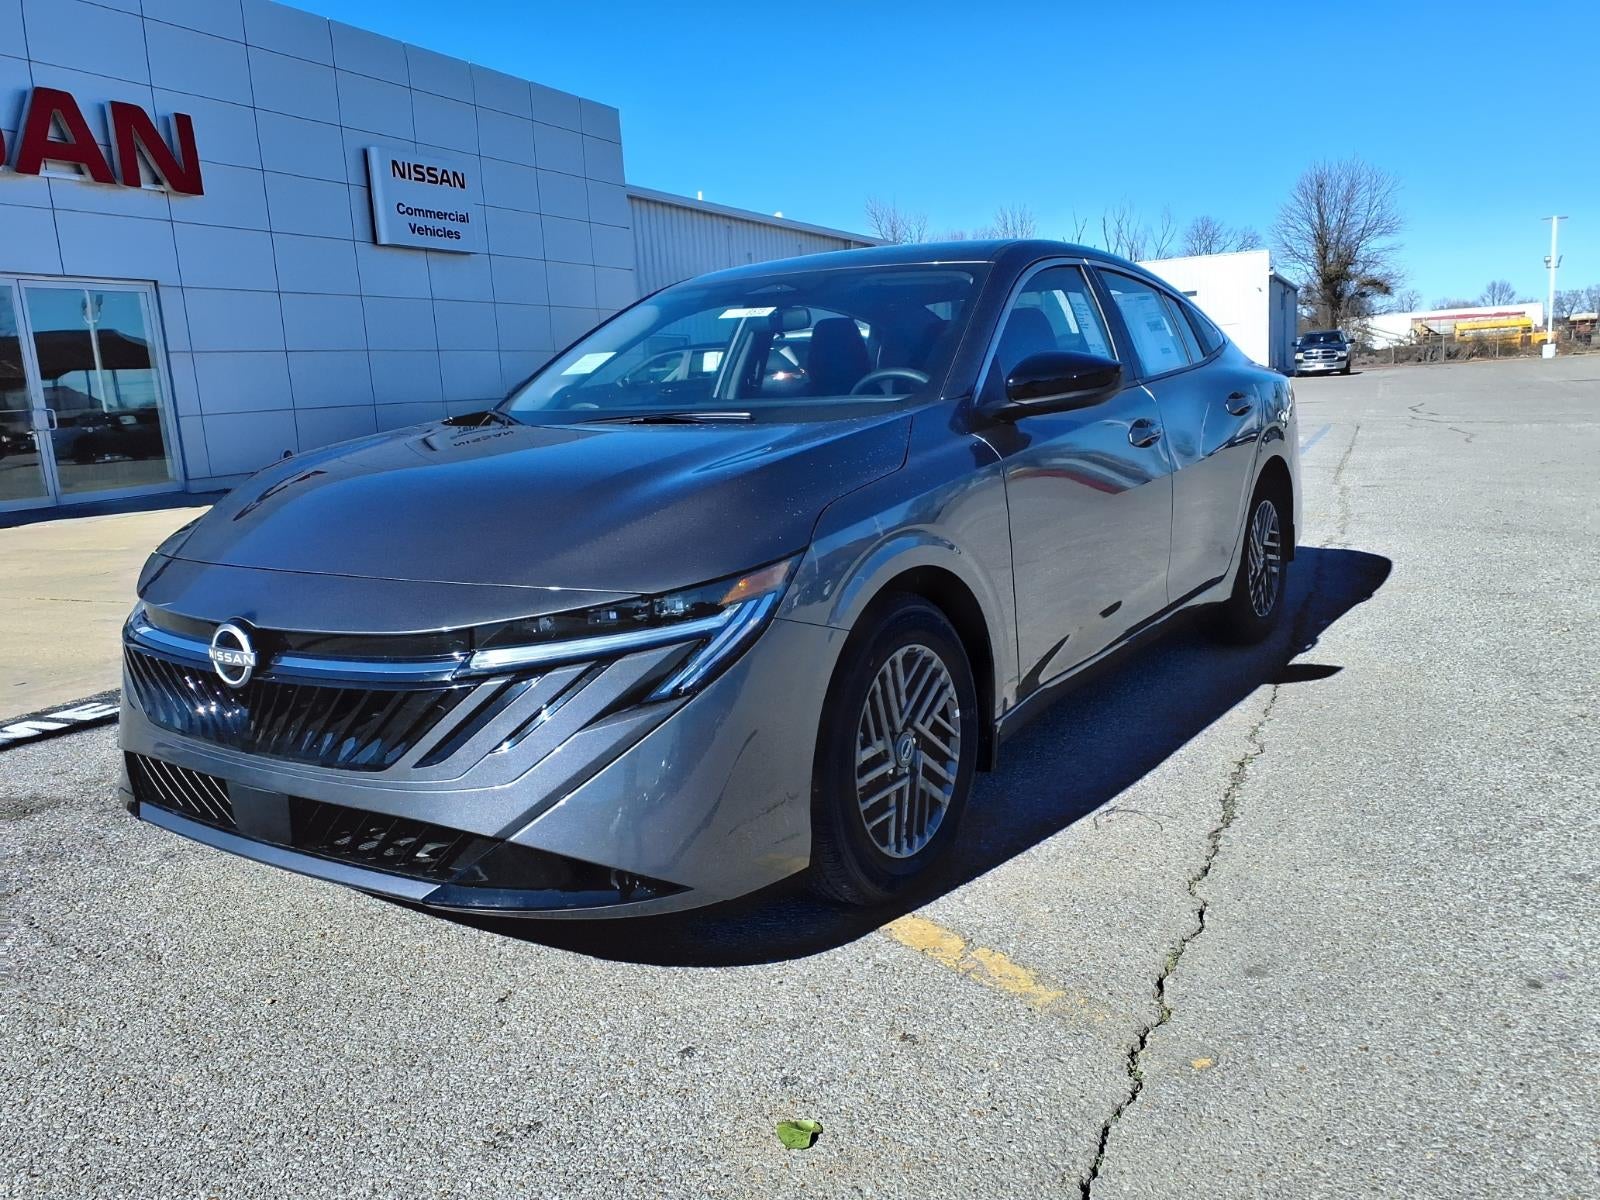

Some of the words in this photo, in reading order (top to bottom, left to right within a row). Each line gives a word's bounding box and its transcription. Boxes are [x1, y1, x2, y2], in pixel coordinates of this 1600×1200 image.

[0, 86, 204, 195] AN
[391, 160, 466, 189] NISSAN
[396, 203, 470, 223] Commercial
[408, 223, 461, 240] Vehicles
[208, 648, 254, 665] NISSAN
